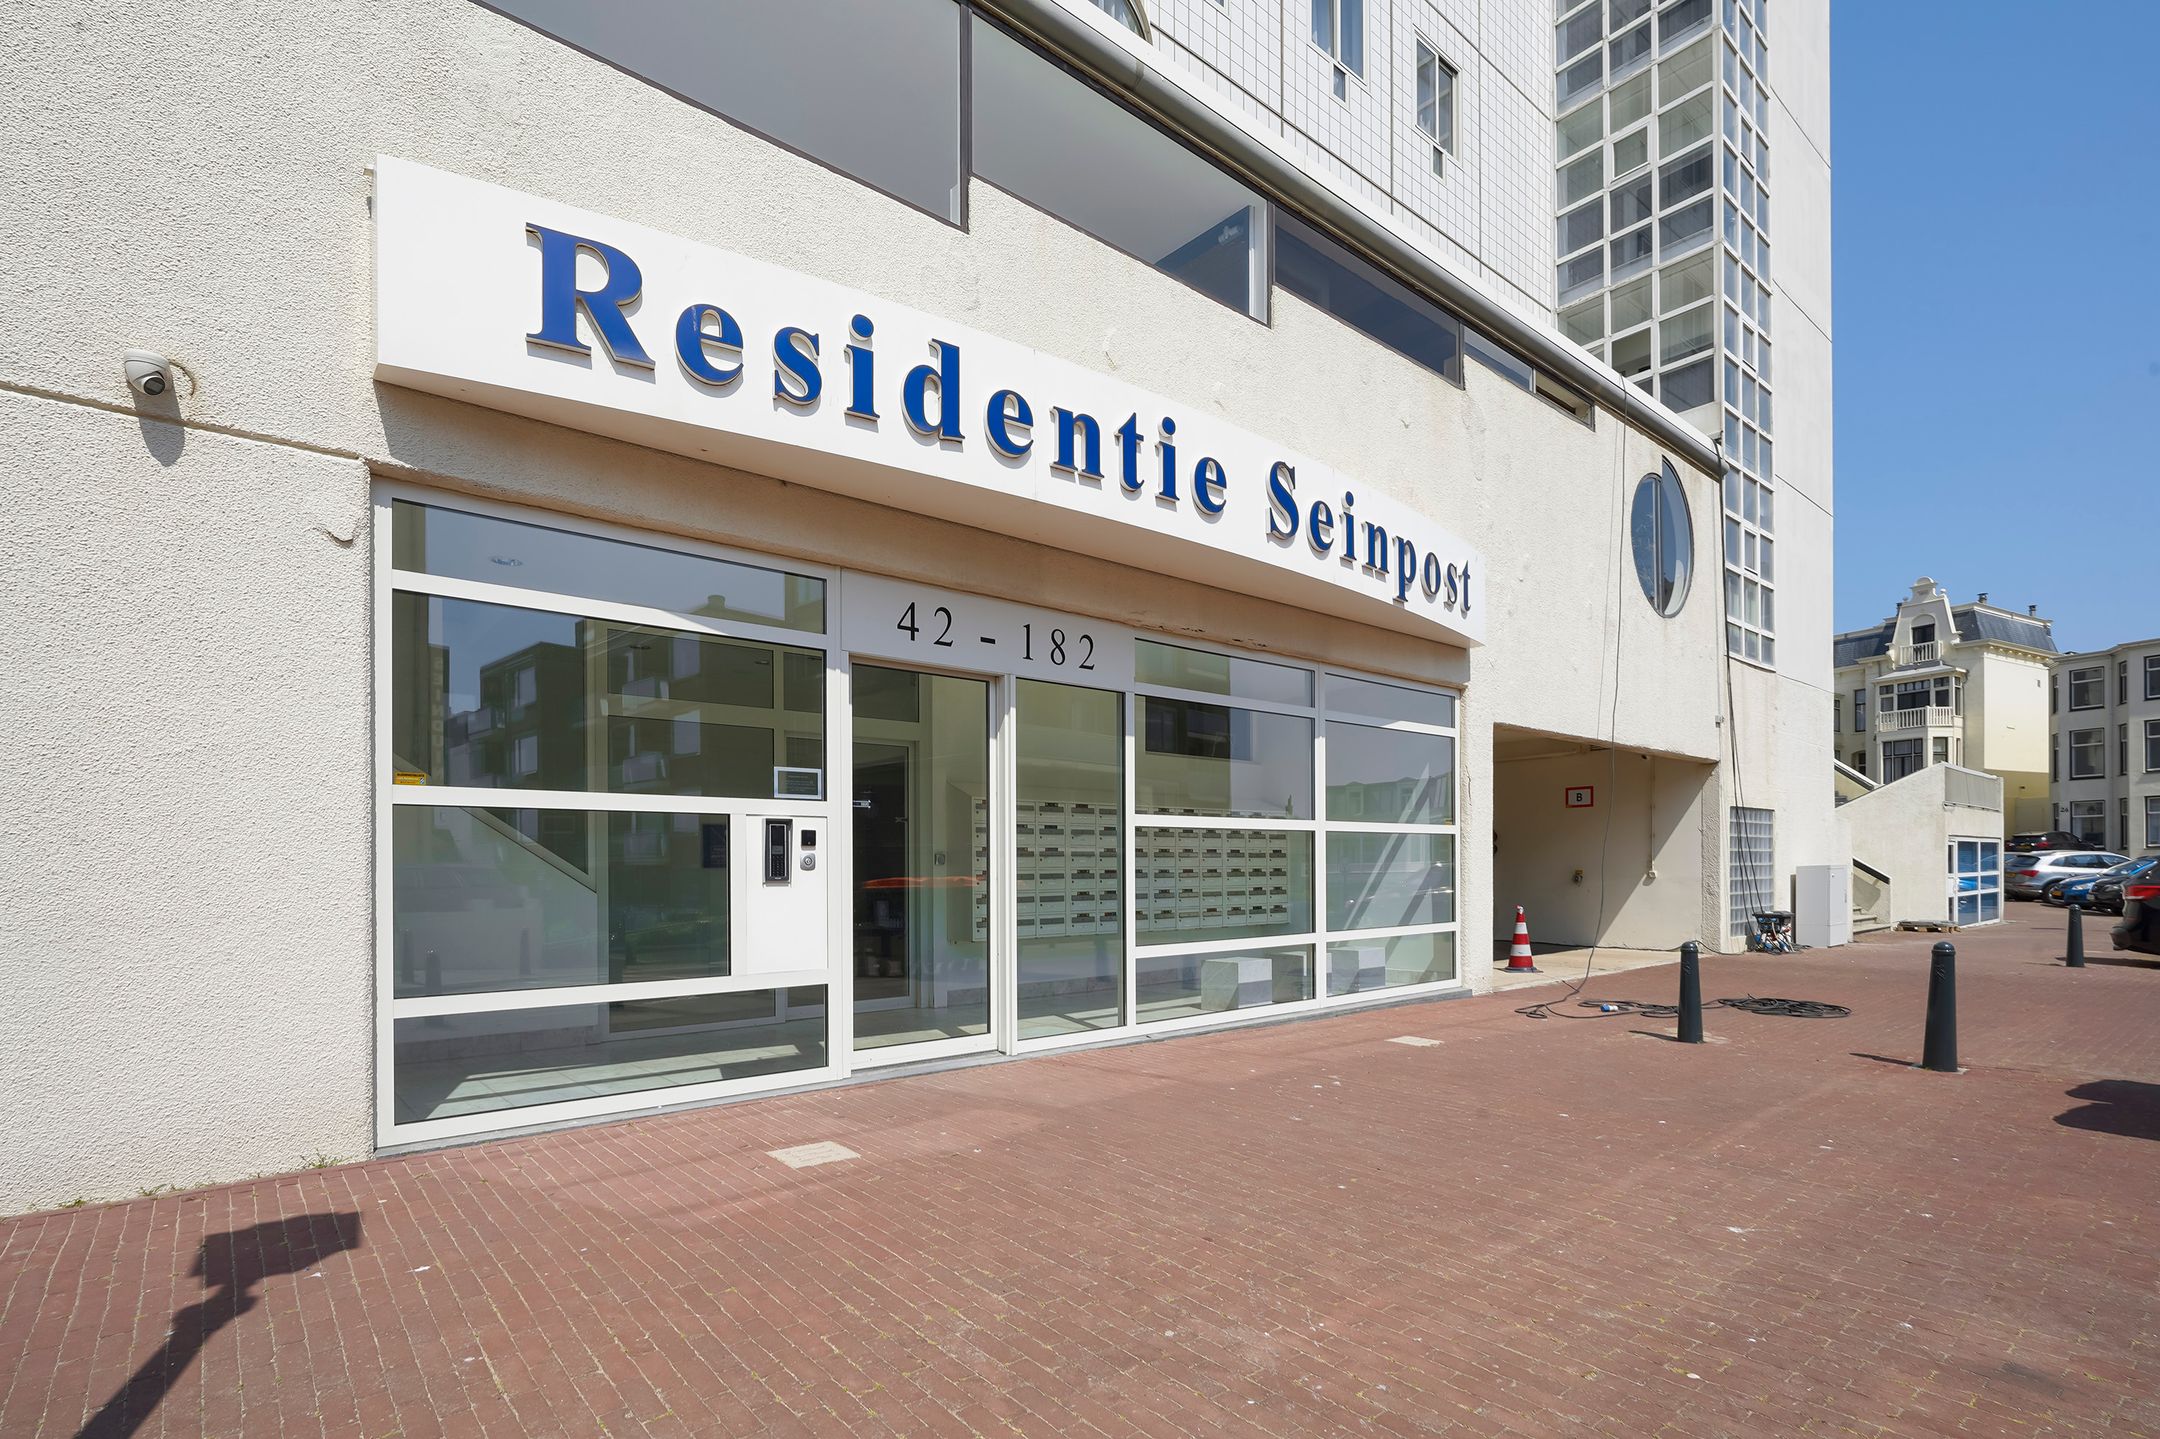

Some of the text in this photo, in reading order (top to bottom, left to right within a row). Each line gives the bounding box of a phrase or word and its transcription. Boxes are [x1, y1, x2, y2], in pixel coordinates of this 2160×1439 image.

[526, 222, 1471, 614] Residentie Seinpost
[897, 601, 954, 647] 42
[1022, 623, 1095, 670] 182
[1576, 792, 1583, 802] B
